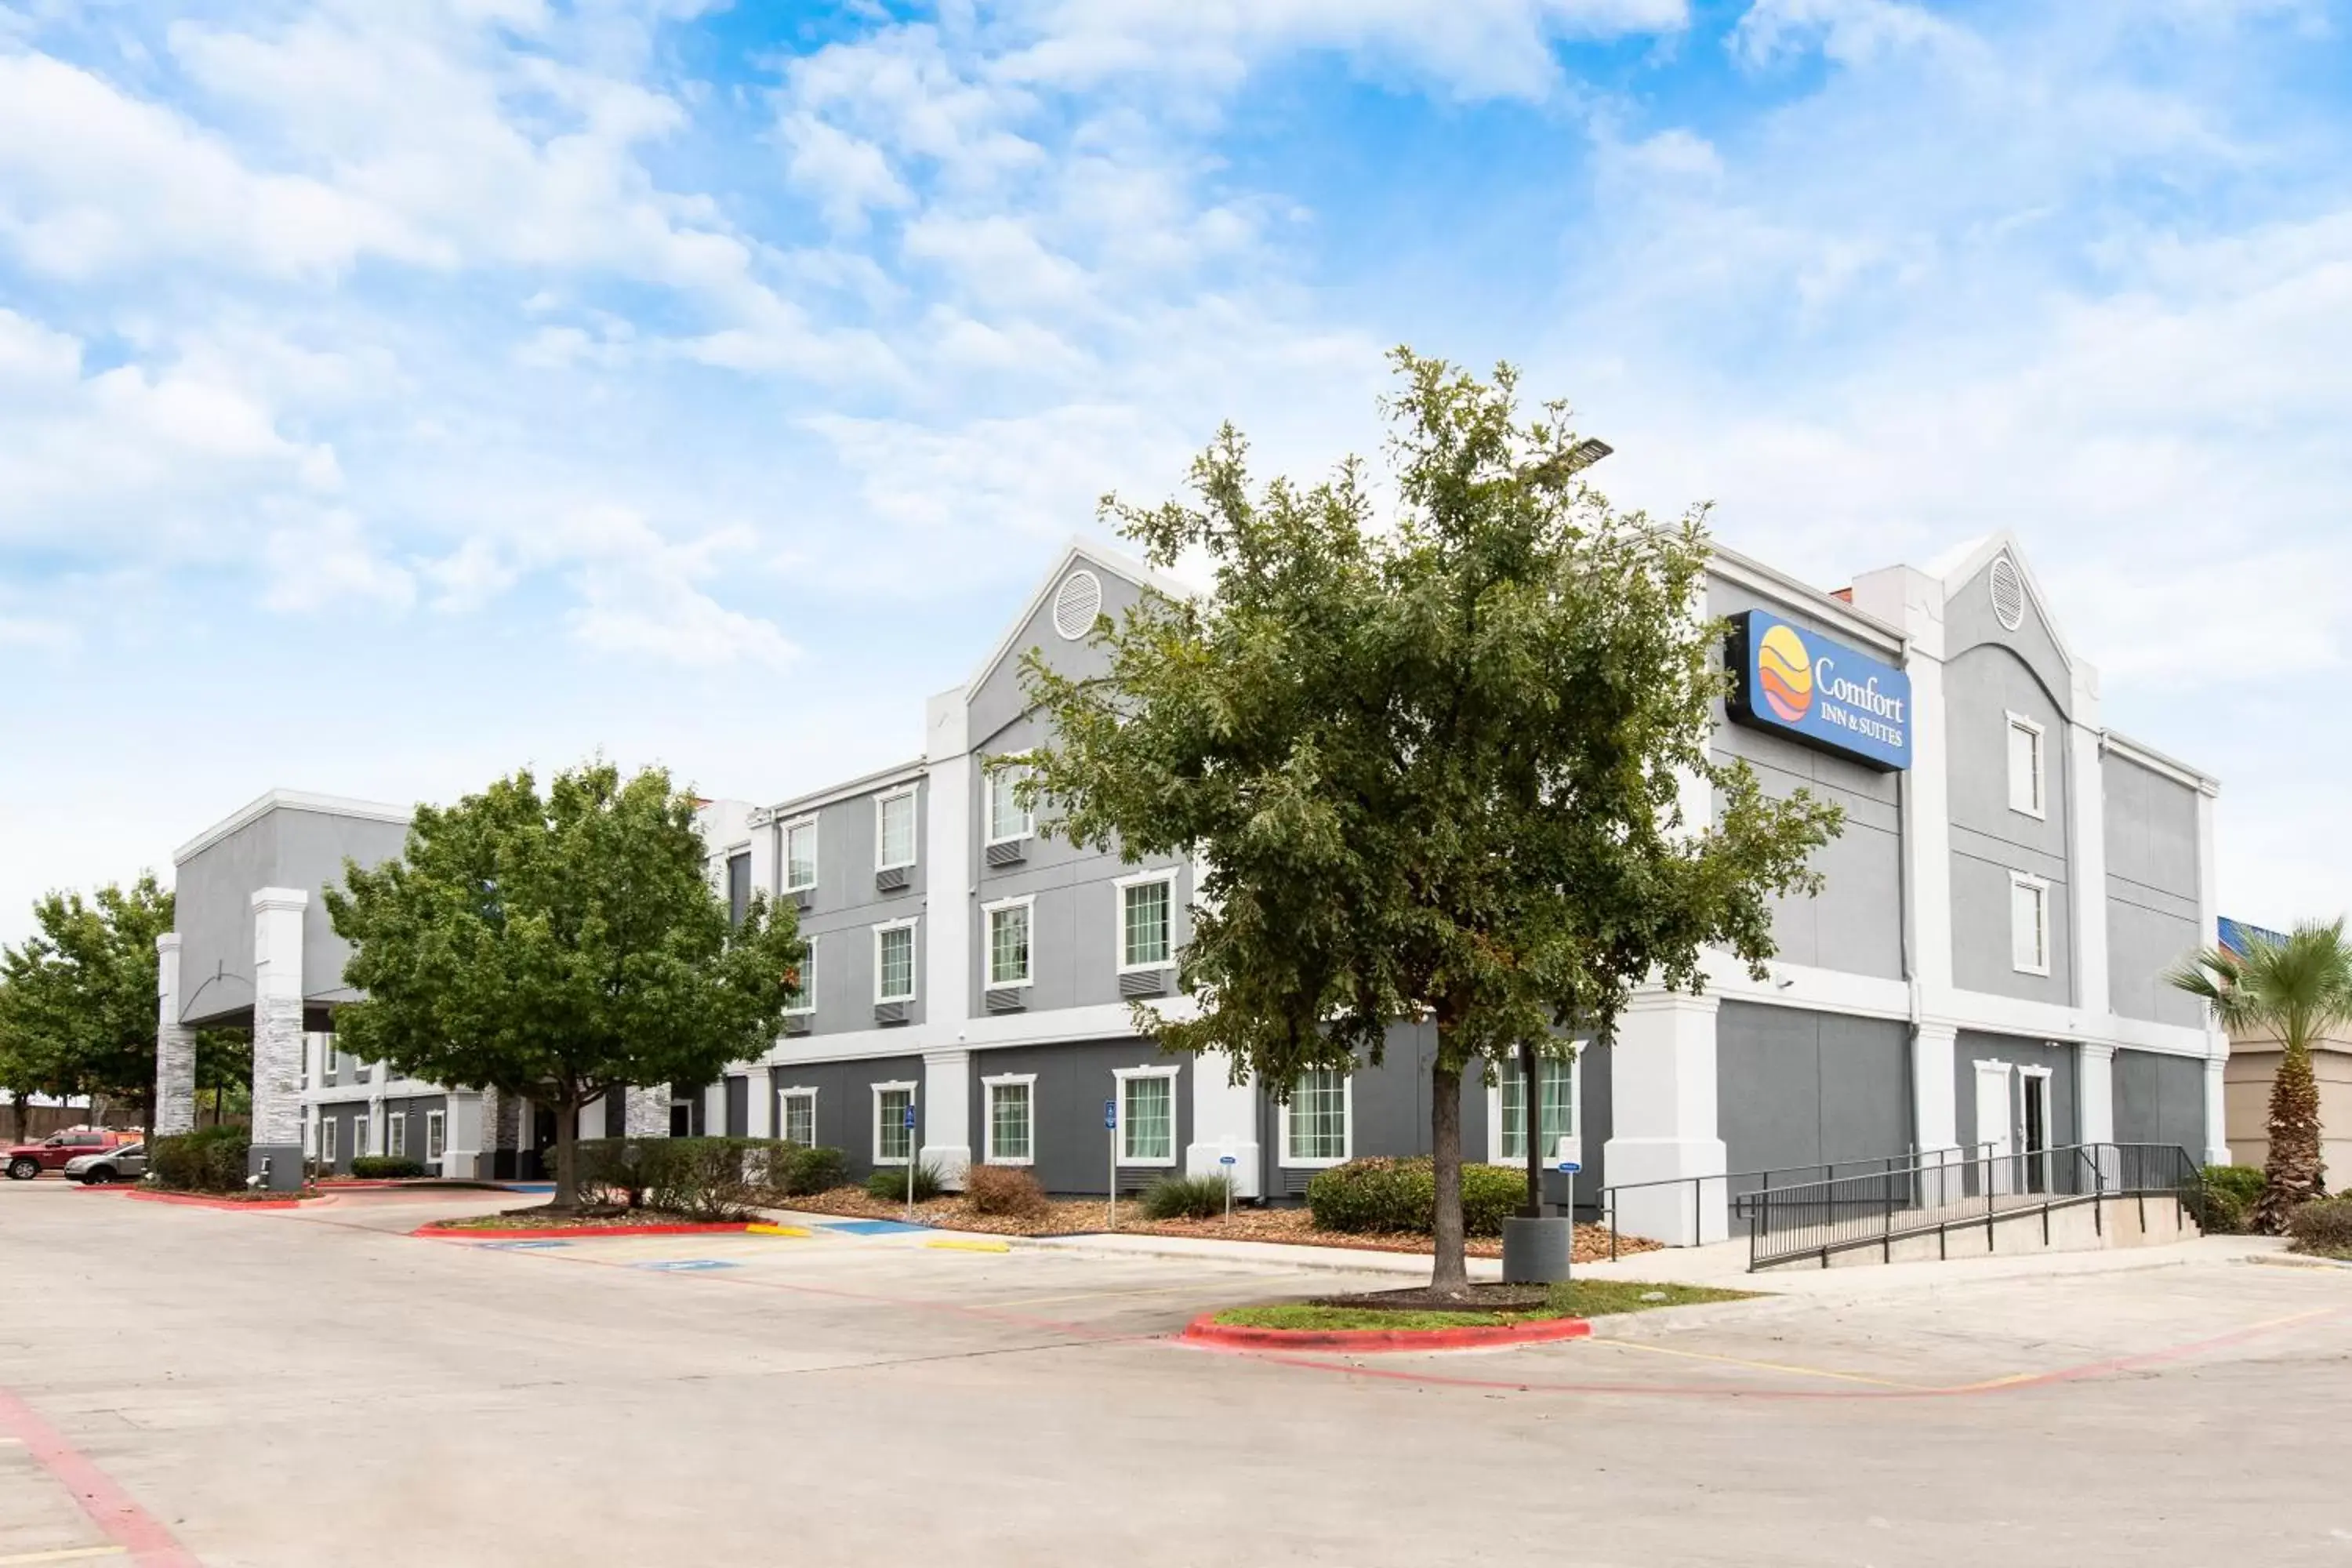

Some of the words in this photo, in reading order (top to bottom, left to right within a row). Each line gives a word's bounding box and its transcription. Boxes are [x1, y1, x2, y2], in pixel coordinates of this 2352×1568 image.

[1815, 657, 1904, 723] Comfort
[1821, 702, 1846, 727] INN
[1849, 714, 1858, 731] &
[1859, 717, 1903, 747] SUITES
